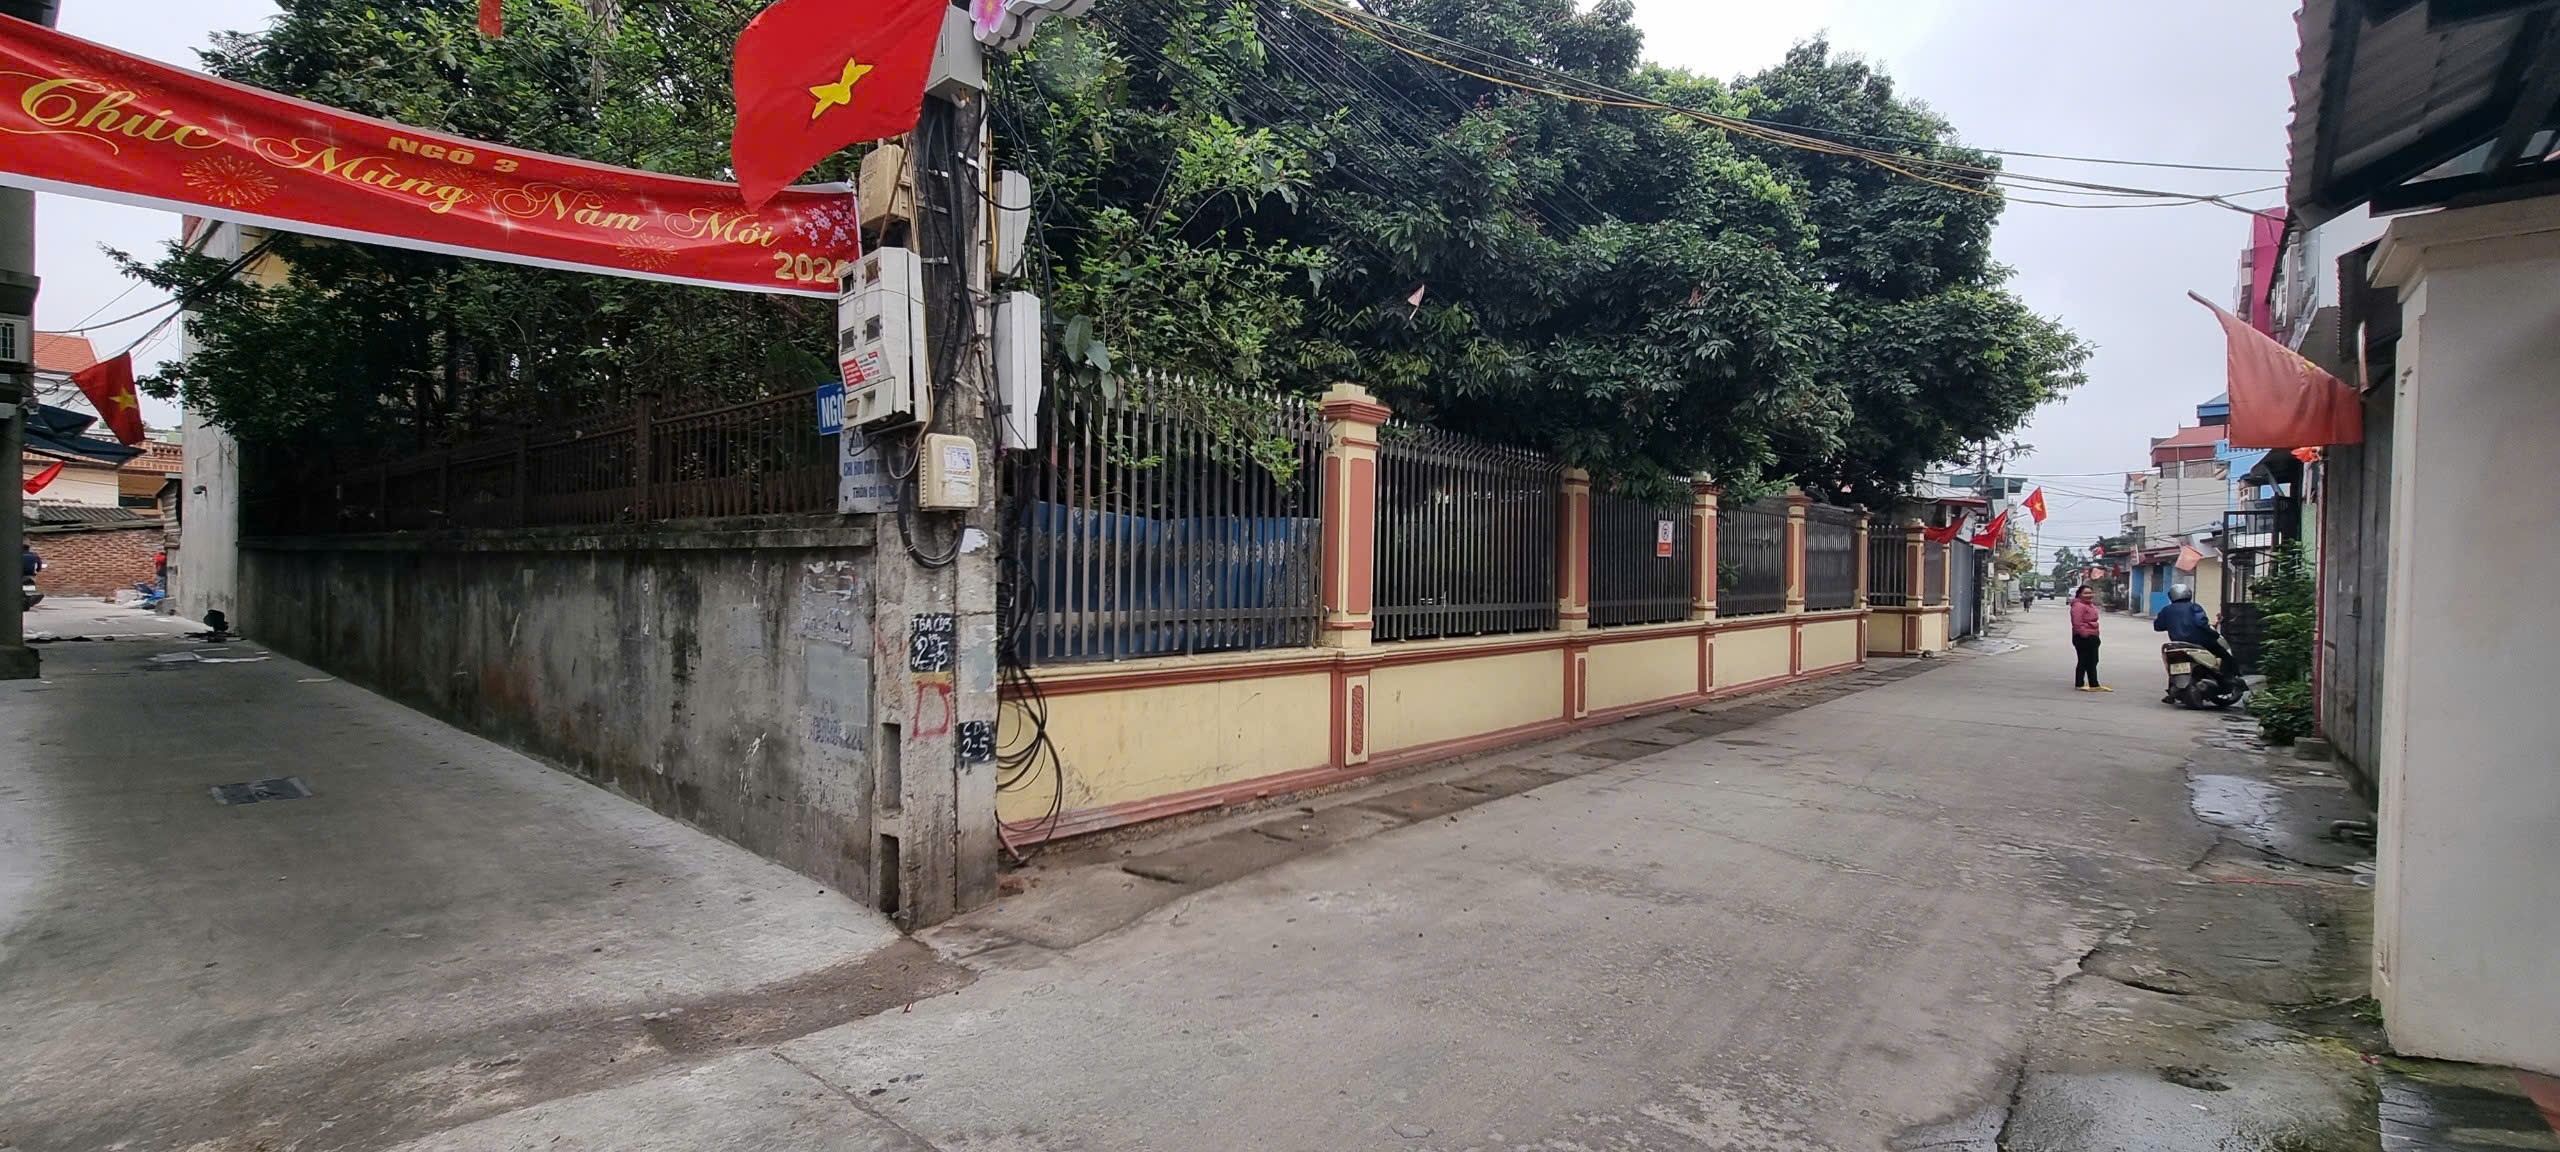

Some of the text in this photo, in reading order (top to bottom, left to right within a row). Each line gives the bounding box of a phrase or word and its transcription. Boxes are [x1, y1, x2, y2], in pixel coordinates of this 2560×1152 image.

[20, 78, 228, 150] Chúc
[493, 182, 648, 232] Năm
[664, 207, 781, 247] Mới
[493, 158, 519, 173] 3
